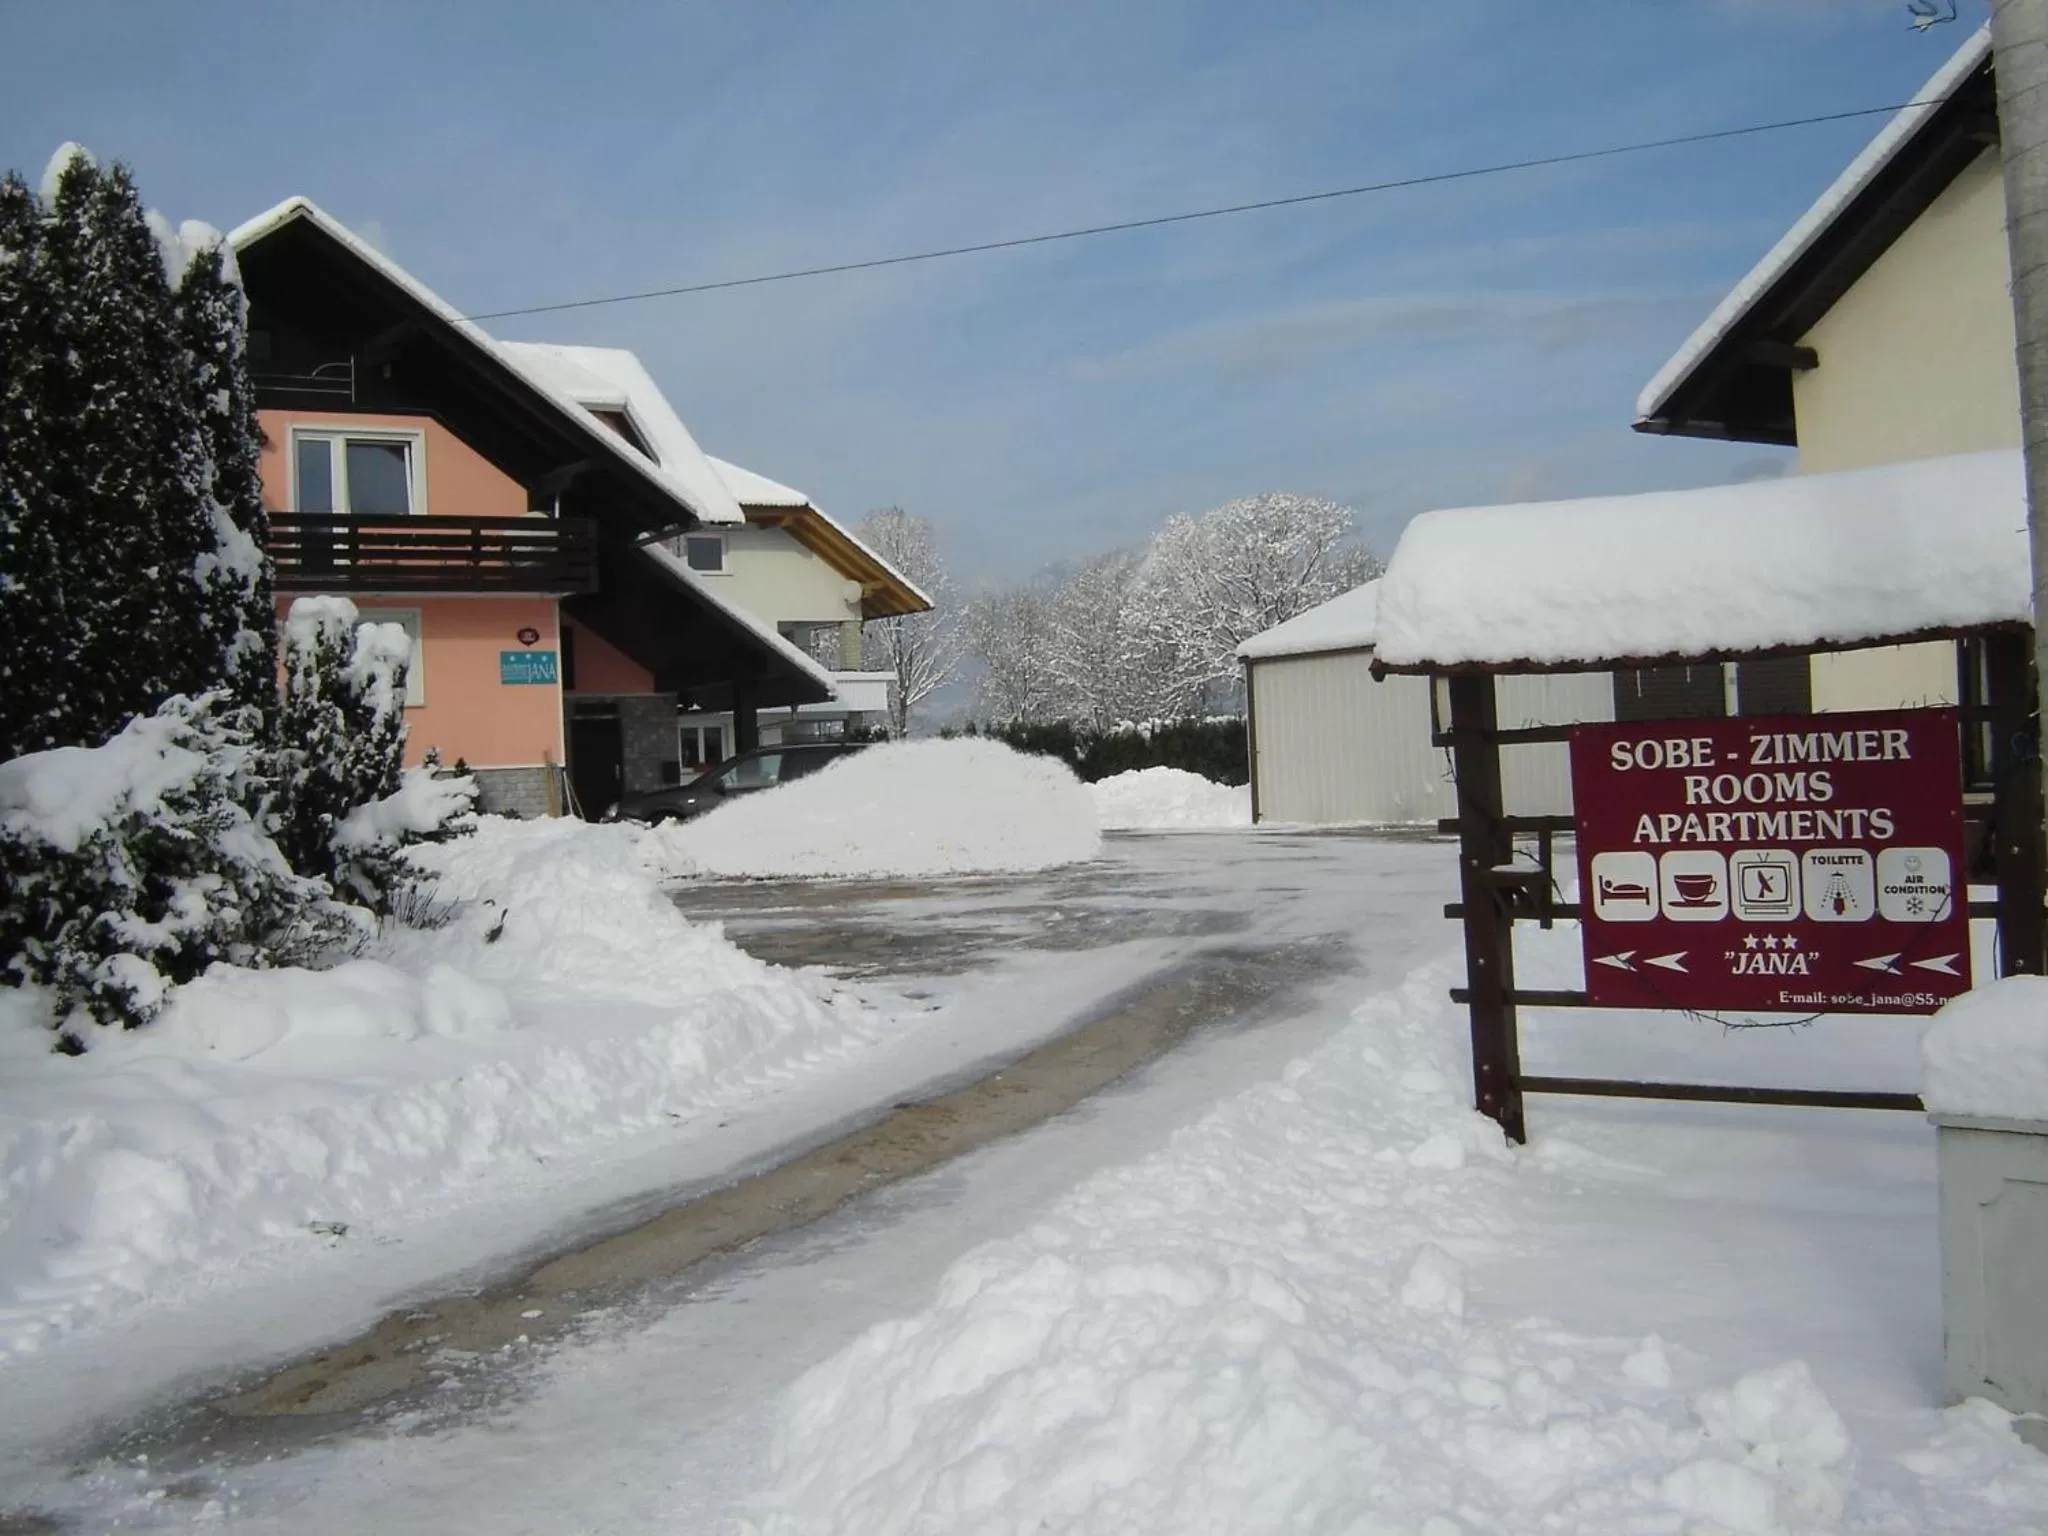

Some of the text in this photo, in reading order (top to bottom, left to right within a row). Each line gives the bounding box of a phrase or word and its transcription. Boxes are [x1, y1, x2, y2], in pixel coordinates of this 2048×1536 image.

[1611, 738, 1716, 771] SOBE
[1750, 729, 1911, 766] ZIMMER
[1684, 771, 1833, 805] ROOMS
[1633, 808, 1894, 844] APARTMENTS
[1811, 855, 1864, 865] TOILETTE
[1905, 875, 1924, 884] AIR
[1884, 885, 1946, 895] CONDITION
[1779, 991, 1827, 1004] E-mail:
